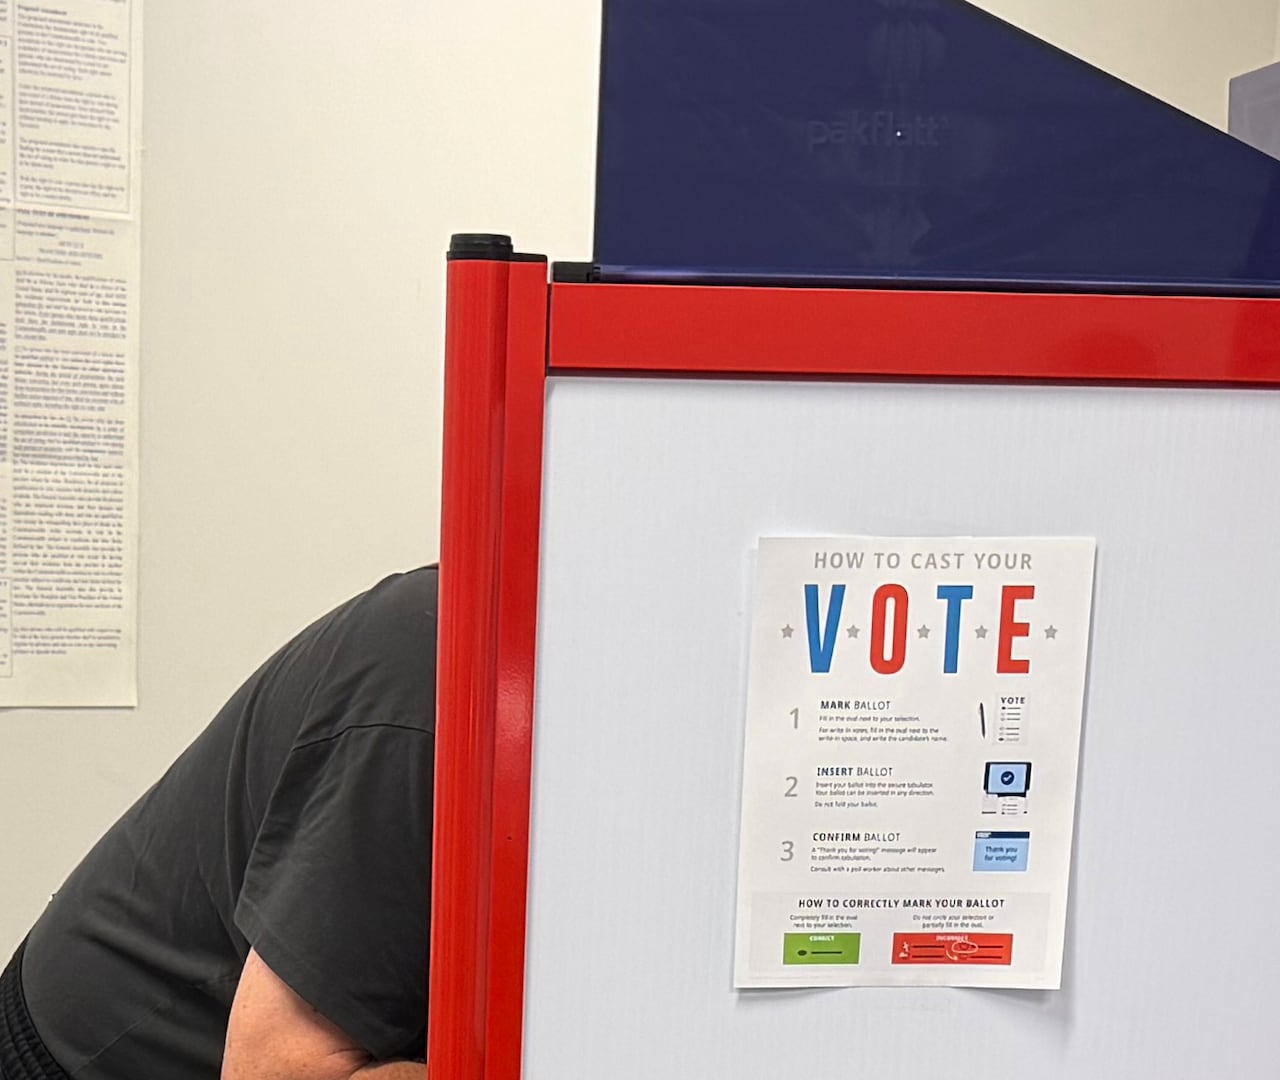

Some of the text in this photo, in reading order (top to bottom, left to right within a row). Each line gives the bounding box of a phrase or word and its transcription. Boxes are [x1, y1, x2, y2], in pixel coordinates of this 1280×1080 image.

[814, 552, 1033, 570] HOW TO CAST YOUR
[804, 583, 1035, 674] VOTE
[821, 701, 891, 710] MARK BALLOT
[790, 707, 799, 729] 1
[817, 768, 893, 777] INSERT BALLOT
[784, 776, 798, 797] 2
[813, 833, 900, 842] CONFIRM BALLOT
[780, 841, 794, 862] 3
[799, 899, 1005, 908] HOW TO CORRECTLY MARK YOUR BALLOT
